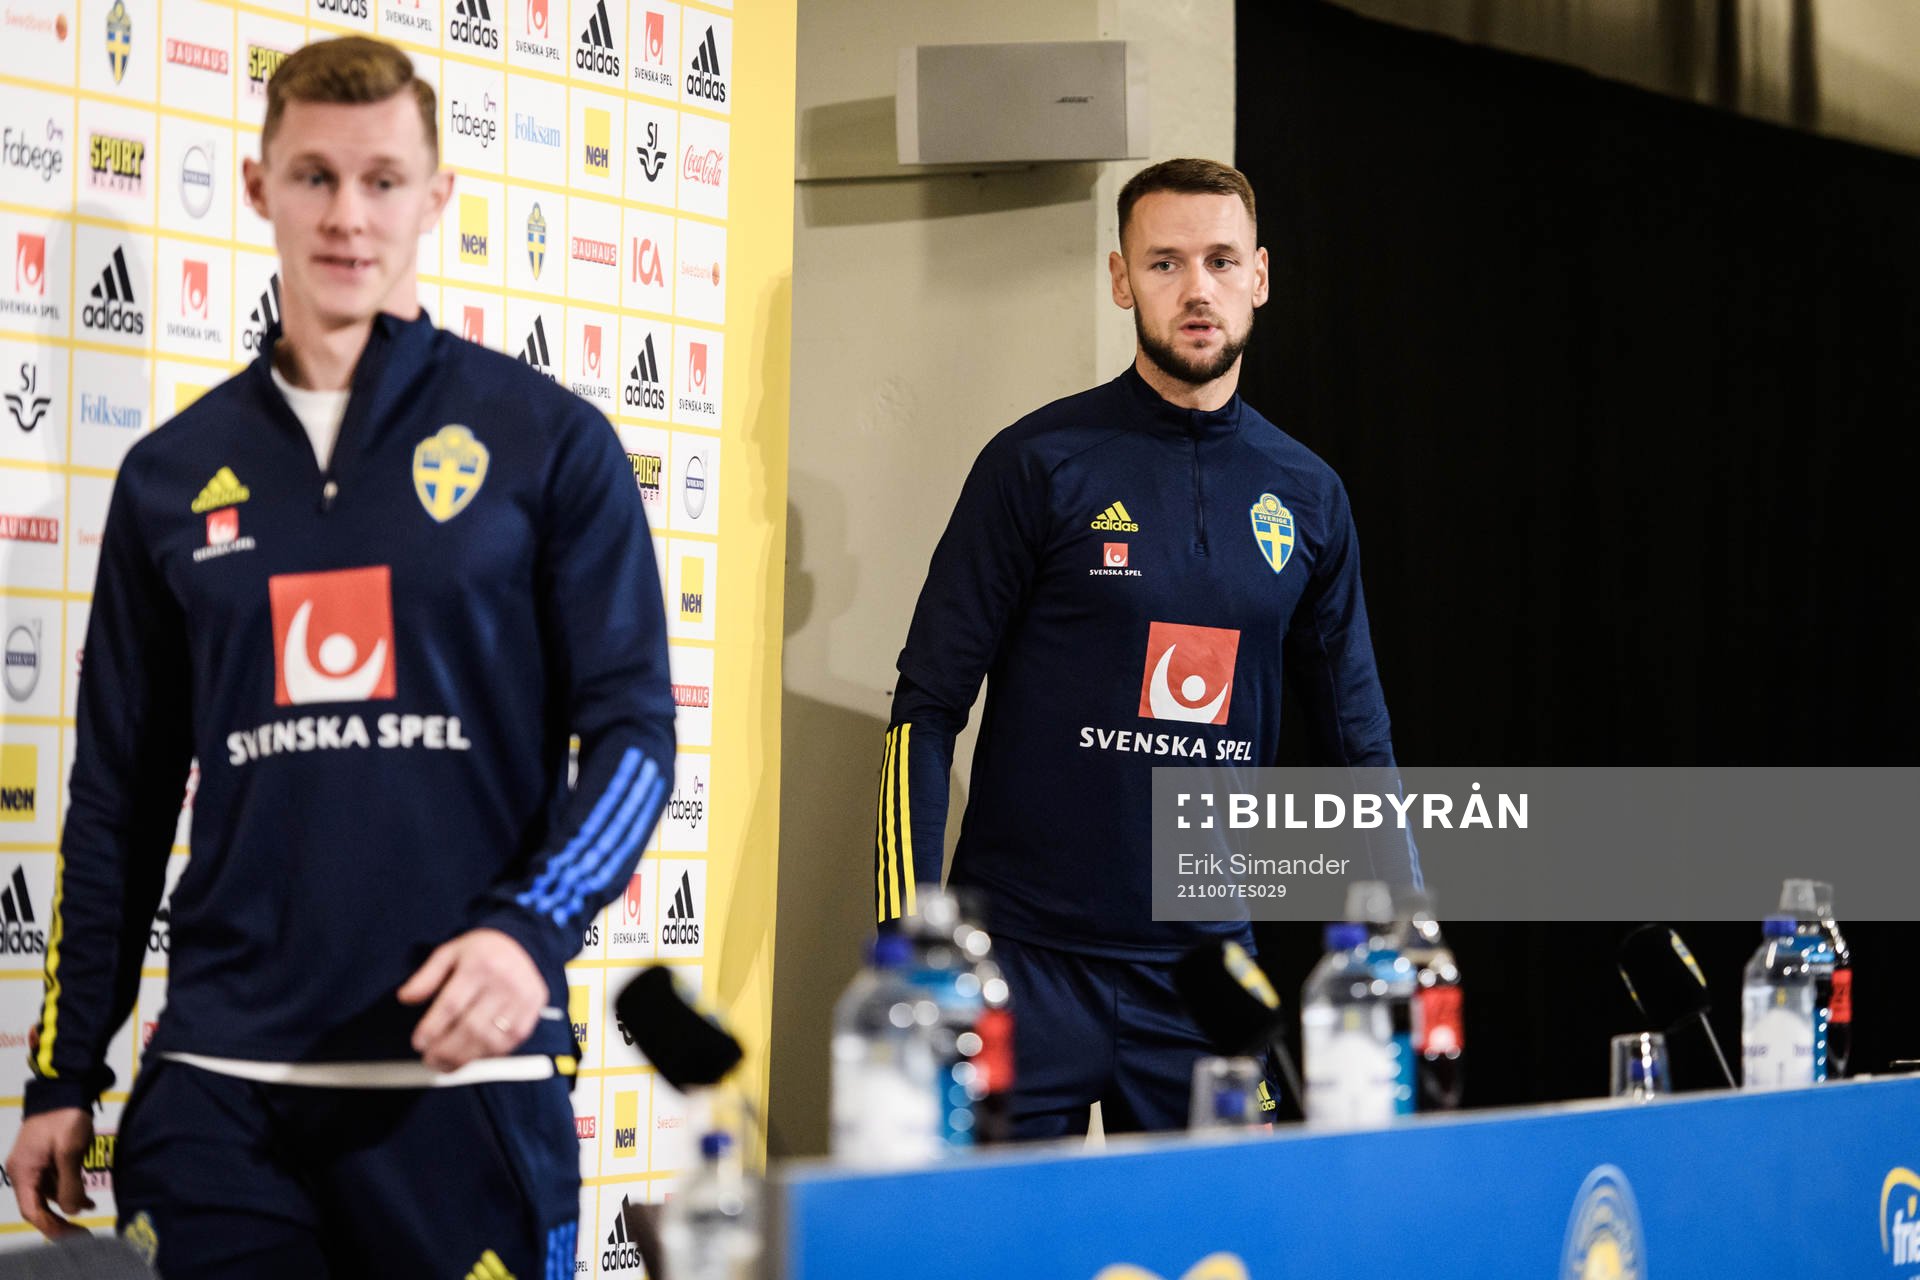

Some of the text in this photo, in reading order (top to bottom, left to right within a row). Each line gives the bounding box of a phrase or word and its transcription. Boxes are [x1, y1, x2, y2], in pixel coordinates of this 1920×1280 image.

[450, 18, 498, 50] adidas
[516, 39, 560, 60] SVENSKA SPEL
[167, 39, 229, 75] BAUHAUS
[576, 45, 620, 77] adidas
[634, 66, 673, 87] SVENSKA SPEL
[686, 71, 726, 103] adidas
[451, 100, 496, 149] Fabege
[515, 112, 561, 148] Folksam
[647, 121, 658, 150] SJ
[2, 124, 63, 182] Fabege
[90, 133, 144, 180] SPORT
[573, 237, 617, 266] BAUHAUS
[633, 236, 664, 288] ICA
[82, 299, 145, 335] adidas
[20, 363, 36, 395] SJ
[625, 379, 665, 411] adidas
[80, 393, 142, 430] Folksam
[679, 398, 716, 415] SVENSKA SPEL
[626, 452, 662, 491] PORT
[0, 516, 58, 543] AUHAUS
[1091, 518, 1139, 533] adidas
[1089, 568, 1143, 578] SVENSKA SPEL
[673, 685, 709, 708] AUHAUS
[227, 713, 471, 766] SVENSKA SPEL
[1080, 726, 1253, 762] SVENSKA SPEL
[662, 917, 700, 945] adidas
[602, 1242, 641, 1272] adidas
